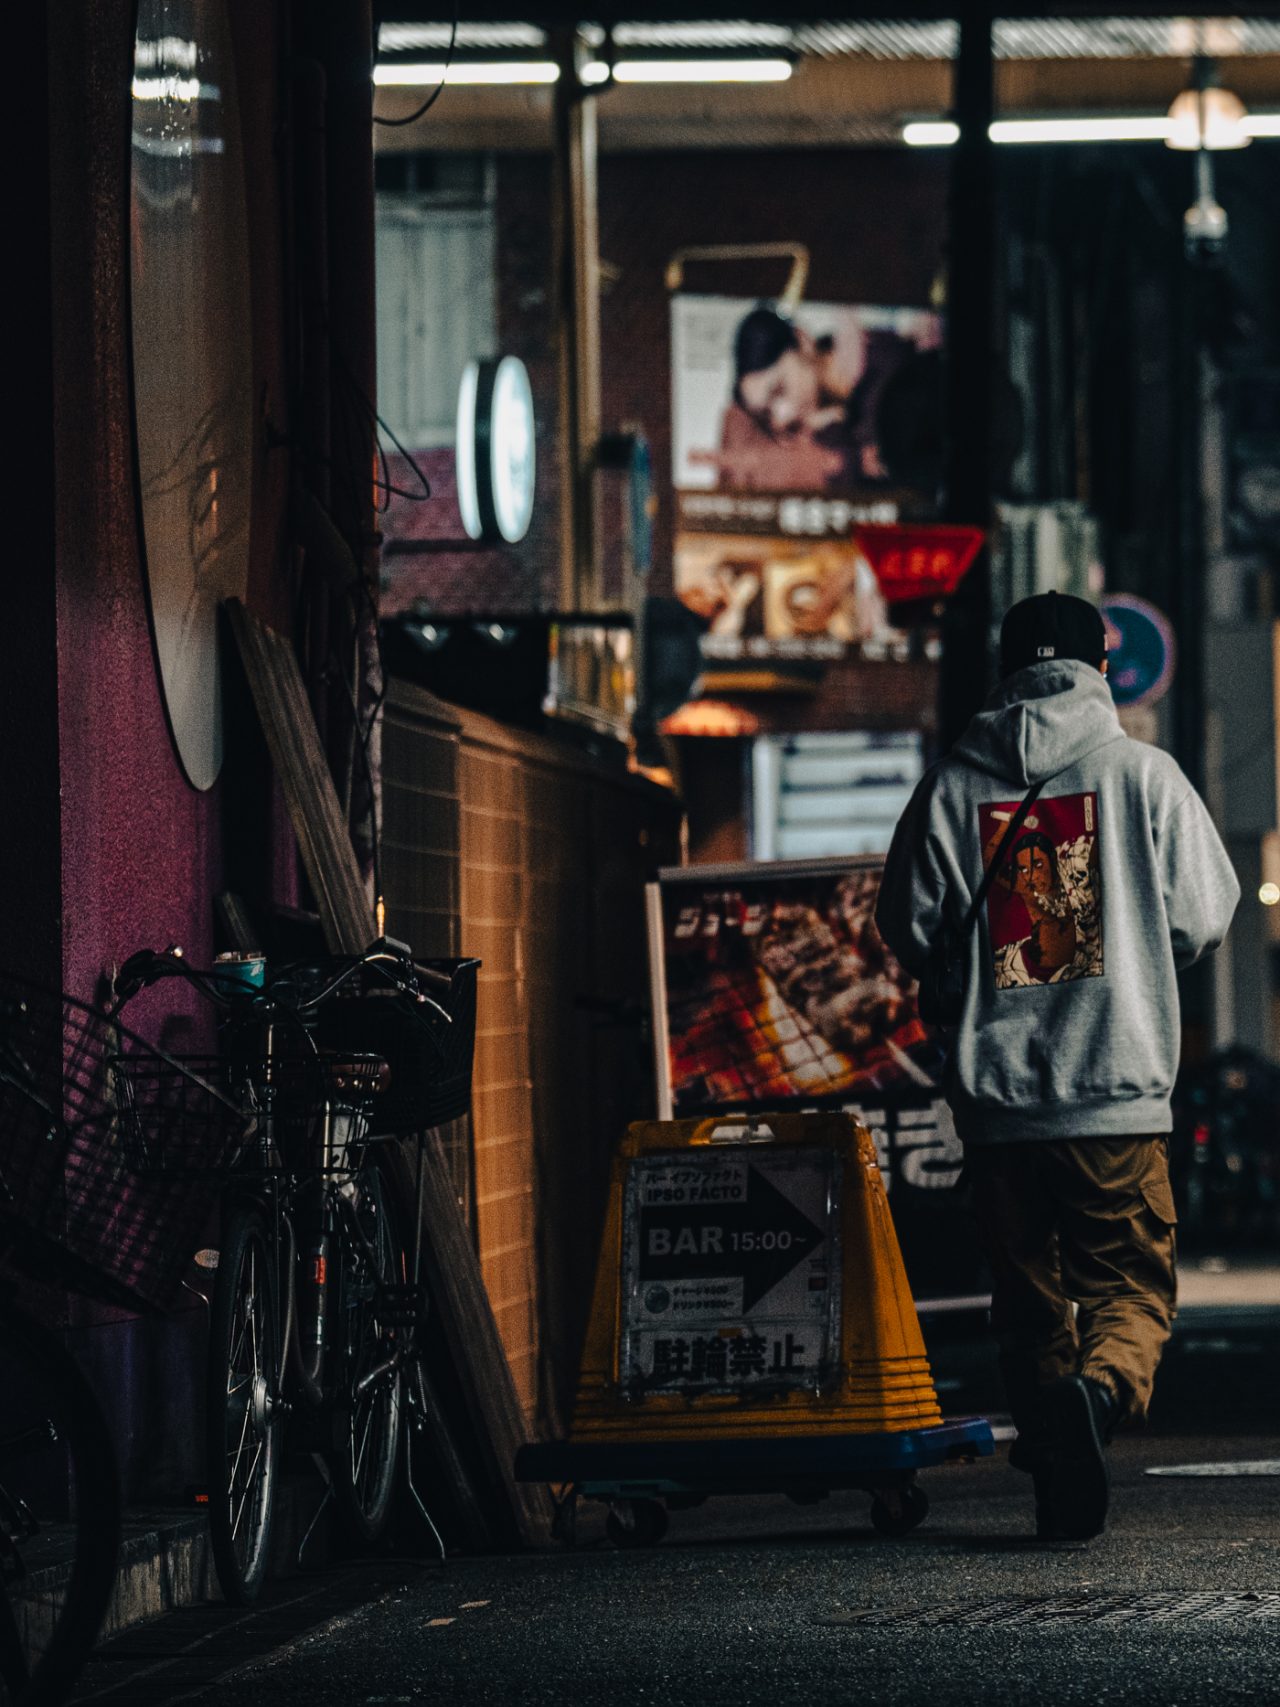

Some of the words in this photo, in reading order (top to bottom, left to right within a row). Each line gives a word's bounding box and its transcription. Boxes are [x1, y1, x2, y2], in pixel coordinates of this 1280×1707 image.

[648, 1187, 684, 1202] IPSO
[689, 1185, 742, 1200] FACTO
[648, 1226, 724, 1257] BAR
[653, 1334, 805, 1378] 駐輪禁止
